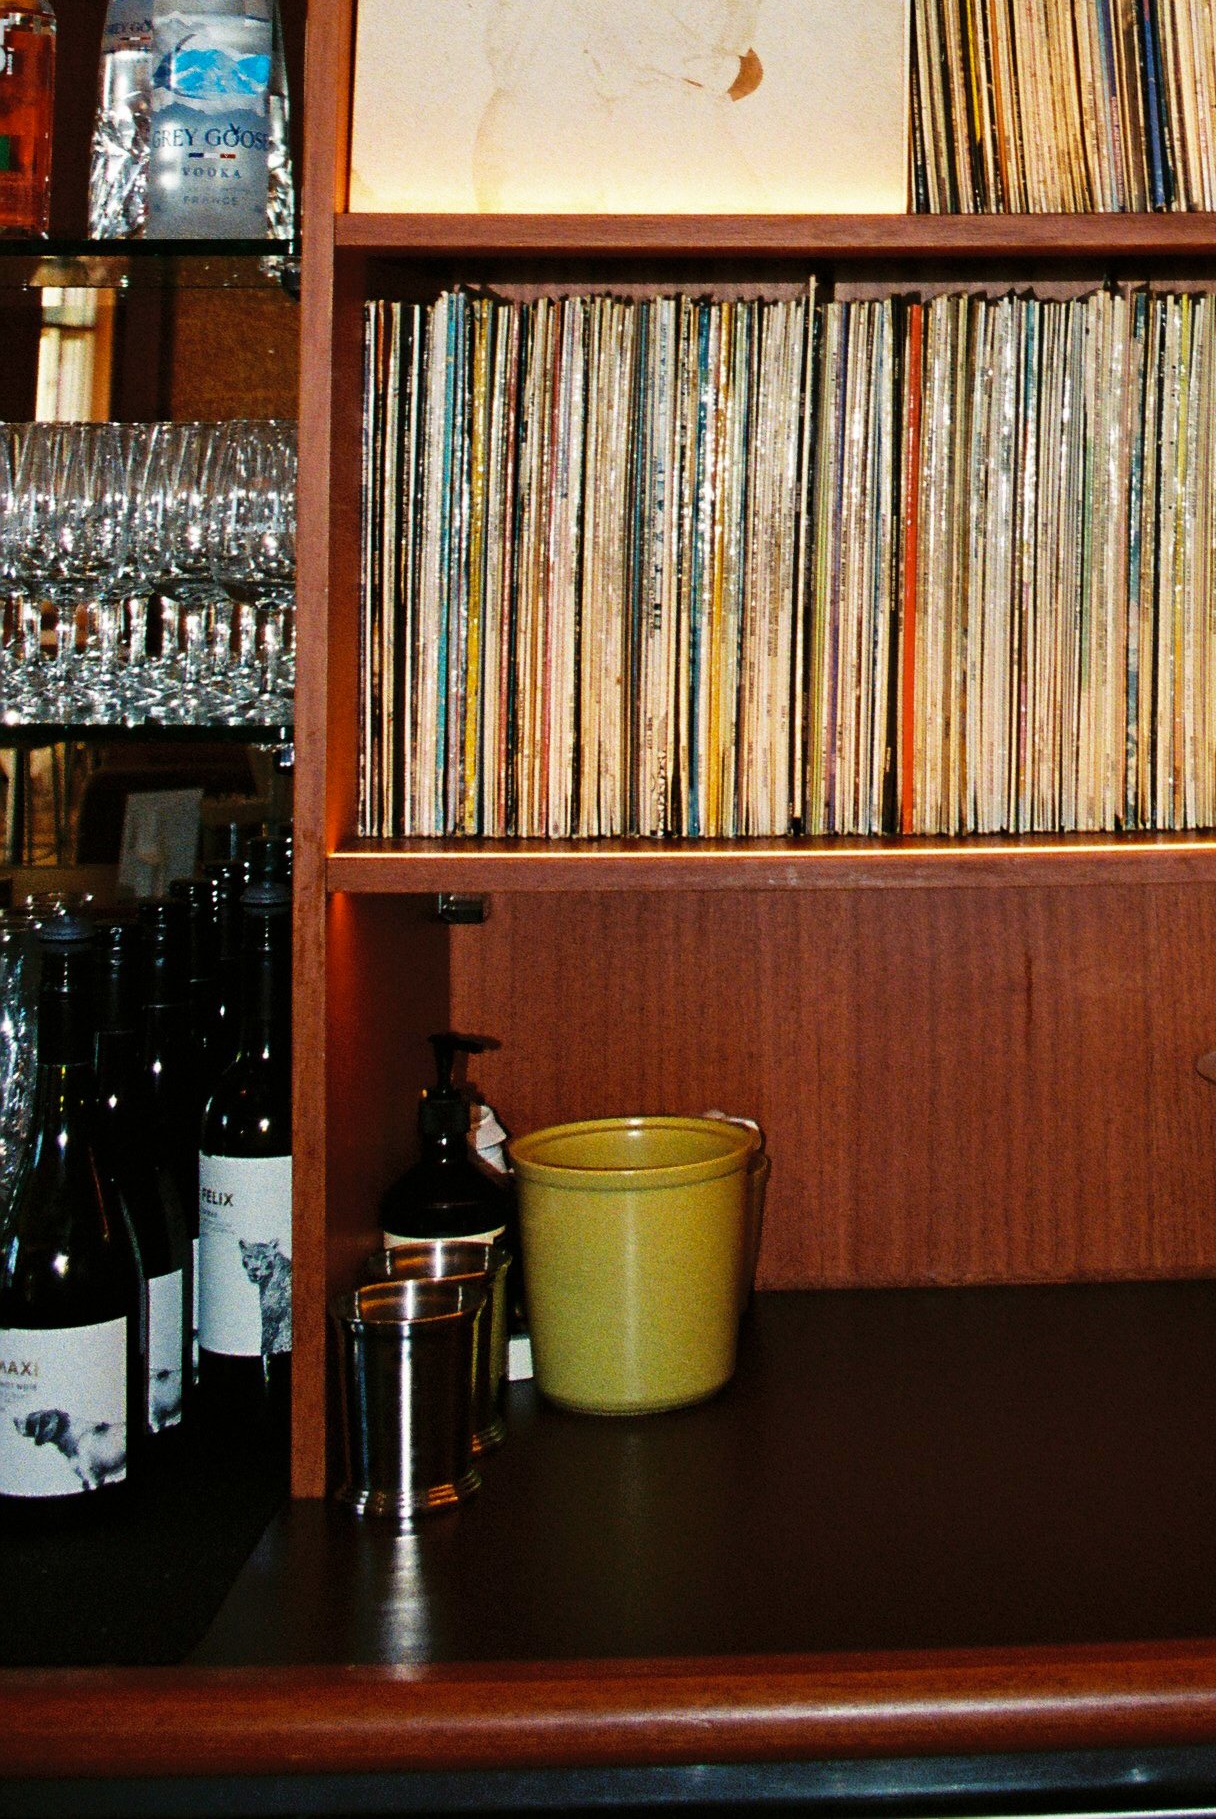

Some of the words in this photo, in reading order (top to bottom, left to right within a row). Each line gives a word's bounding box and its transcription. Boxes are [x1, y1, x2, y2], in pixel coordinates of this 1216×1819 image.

[152, 128, 193, 149] GREY
[205, 123, 269, 151] GOOSE
[182, 167, 242, 179] VODKA
[201, 1187, 234, 1207] FELIX
